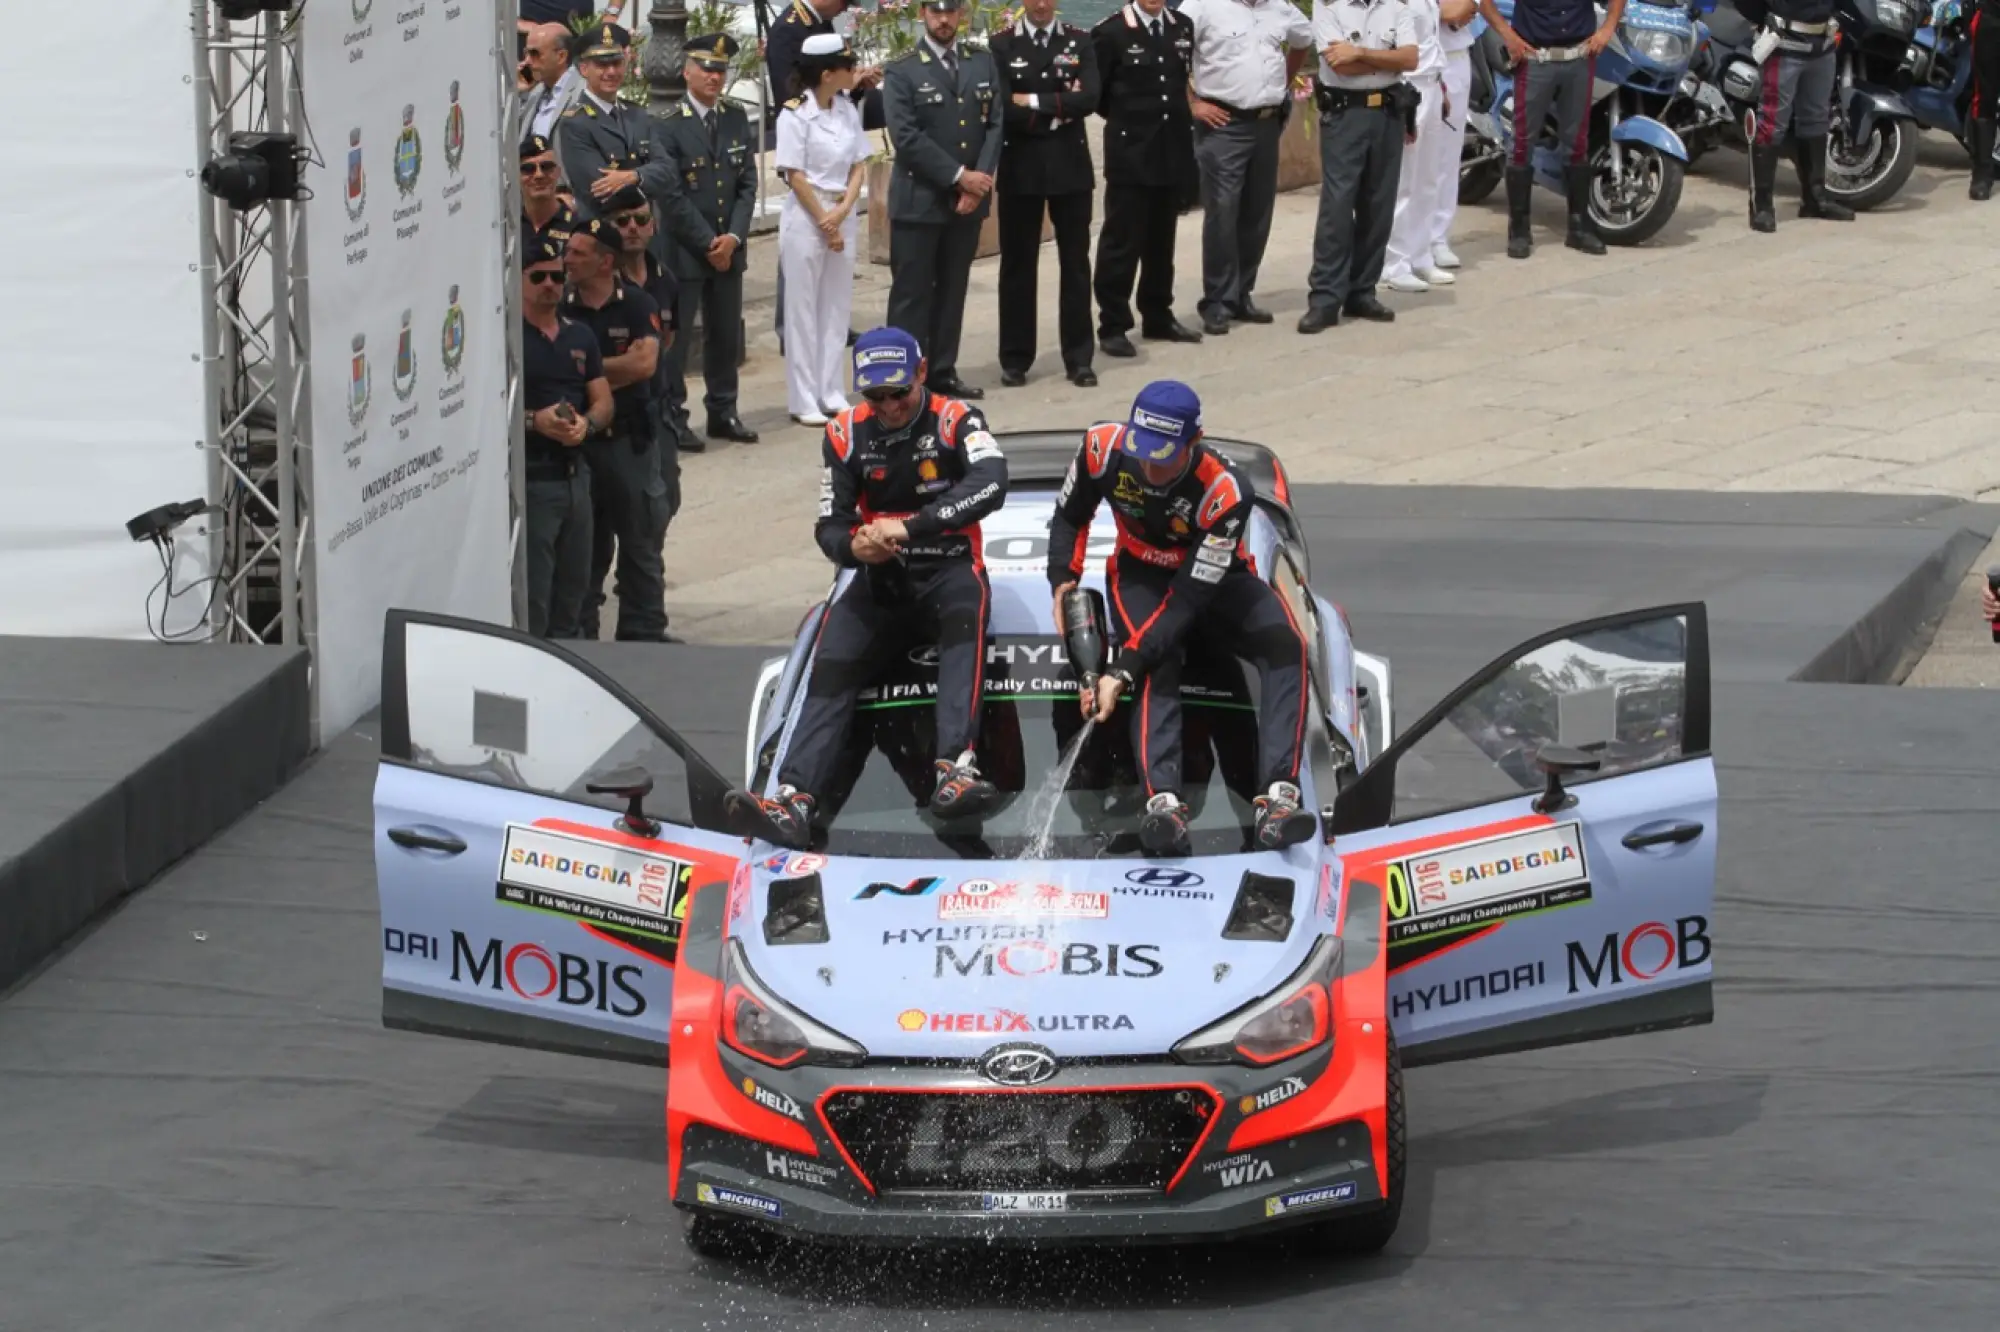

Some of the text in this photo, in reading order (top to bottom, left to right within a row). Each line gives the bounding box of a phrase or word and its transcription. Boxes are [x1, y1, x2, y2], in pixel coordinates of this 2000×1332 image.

[893, 683, 921, 697] FIA
[984, 677, 1026, 693] Rally
[511, 847, 632, 888] SARDEGNA
[1415, 860, 1447, 905] 2016
[1448, 845, 1576, 885] SARDEGNA
[637, 862, 669, 908] 2016
[1112, 886, 1215, 901] HYUNDAI
[538, 895, 669, 933] FIA World Rally Championship
[1403, 897, 1537, 936] FIA World Rally Championship
[450, 929, 648, 1017] MOBIS
[934, 941, 1165, 978] MOBIS
[1393, 961, 1546, 1018] HYUNDAI
[931, 1007, 1136, 1032] HELIX ULTRA
[755, 1085, 806, 1121] HELIX
[1256, 1076, 1308, 1110] HELIX
[788, 1159, 838, 1180] HYUNDAI
[790, 1170, 827, 1186] STEEL
[1203, 1153, 1252, 1174] HYUNDAI
[719, 1190, 778, 1212] MICHELIN
[993, 1195, 1064, 1210] ALZ WR11
[1287, 1185, 1351, 1207] MICHELIN
